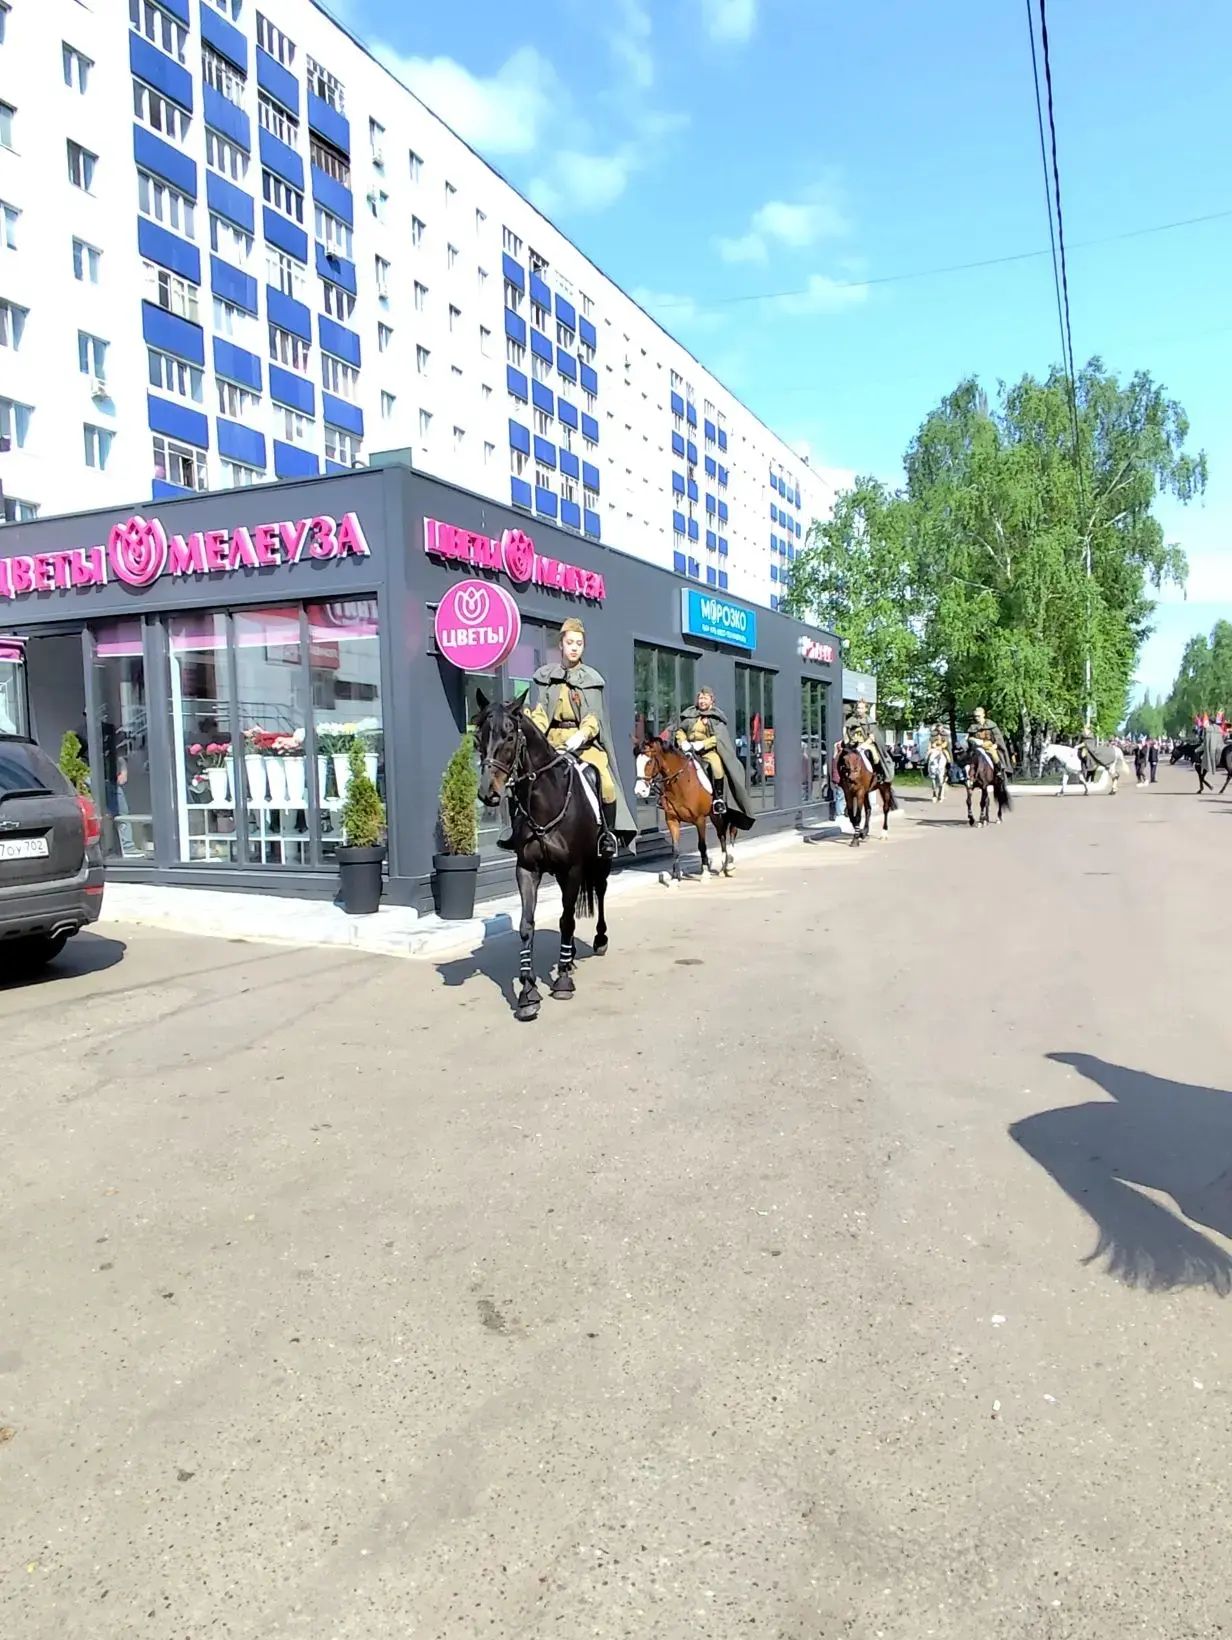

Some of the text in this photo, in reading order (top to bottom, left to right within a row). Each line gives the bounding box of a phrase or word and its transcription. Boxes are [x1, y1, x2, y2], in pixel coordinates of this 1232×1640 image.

[169, 512, 371, 577] МЕЛЕУЗА
[700, 597, 747, 632] МОРОЗКО
[442, 626, 504, 648] ЦВЕТЫ
